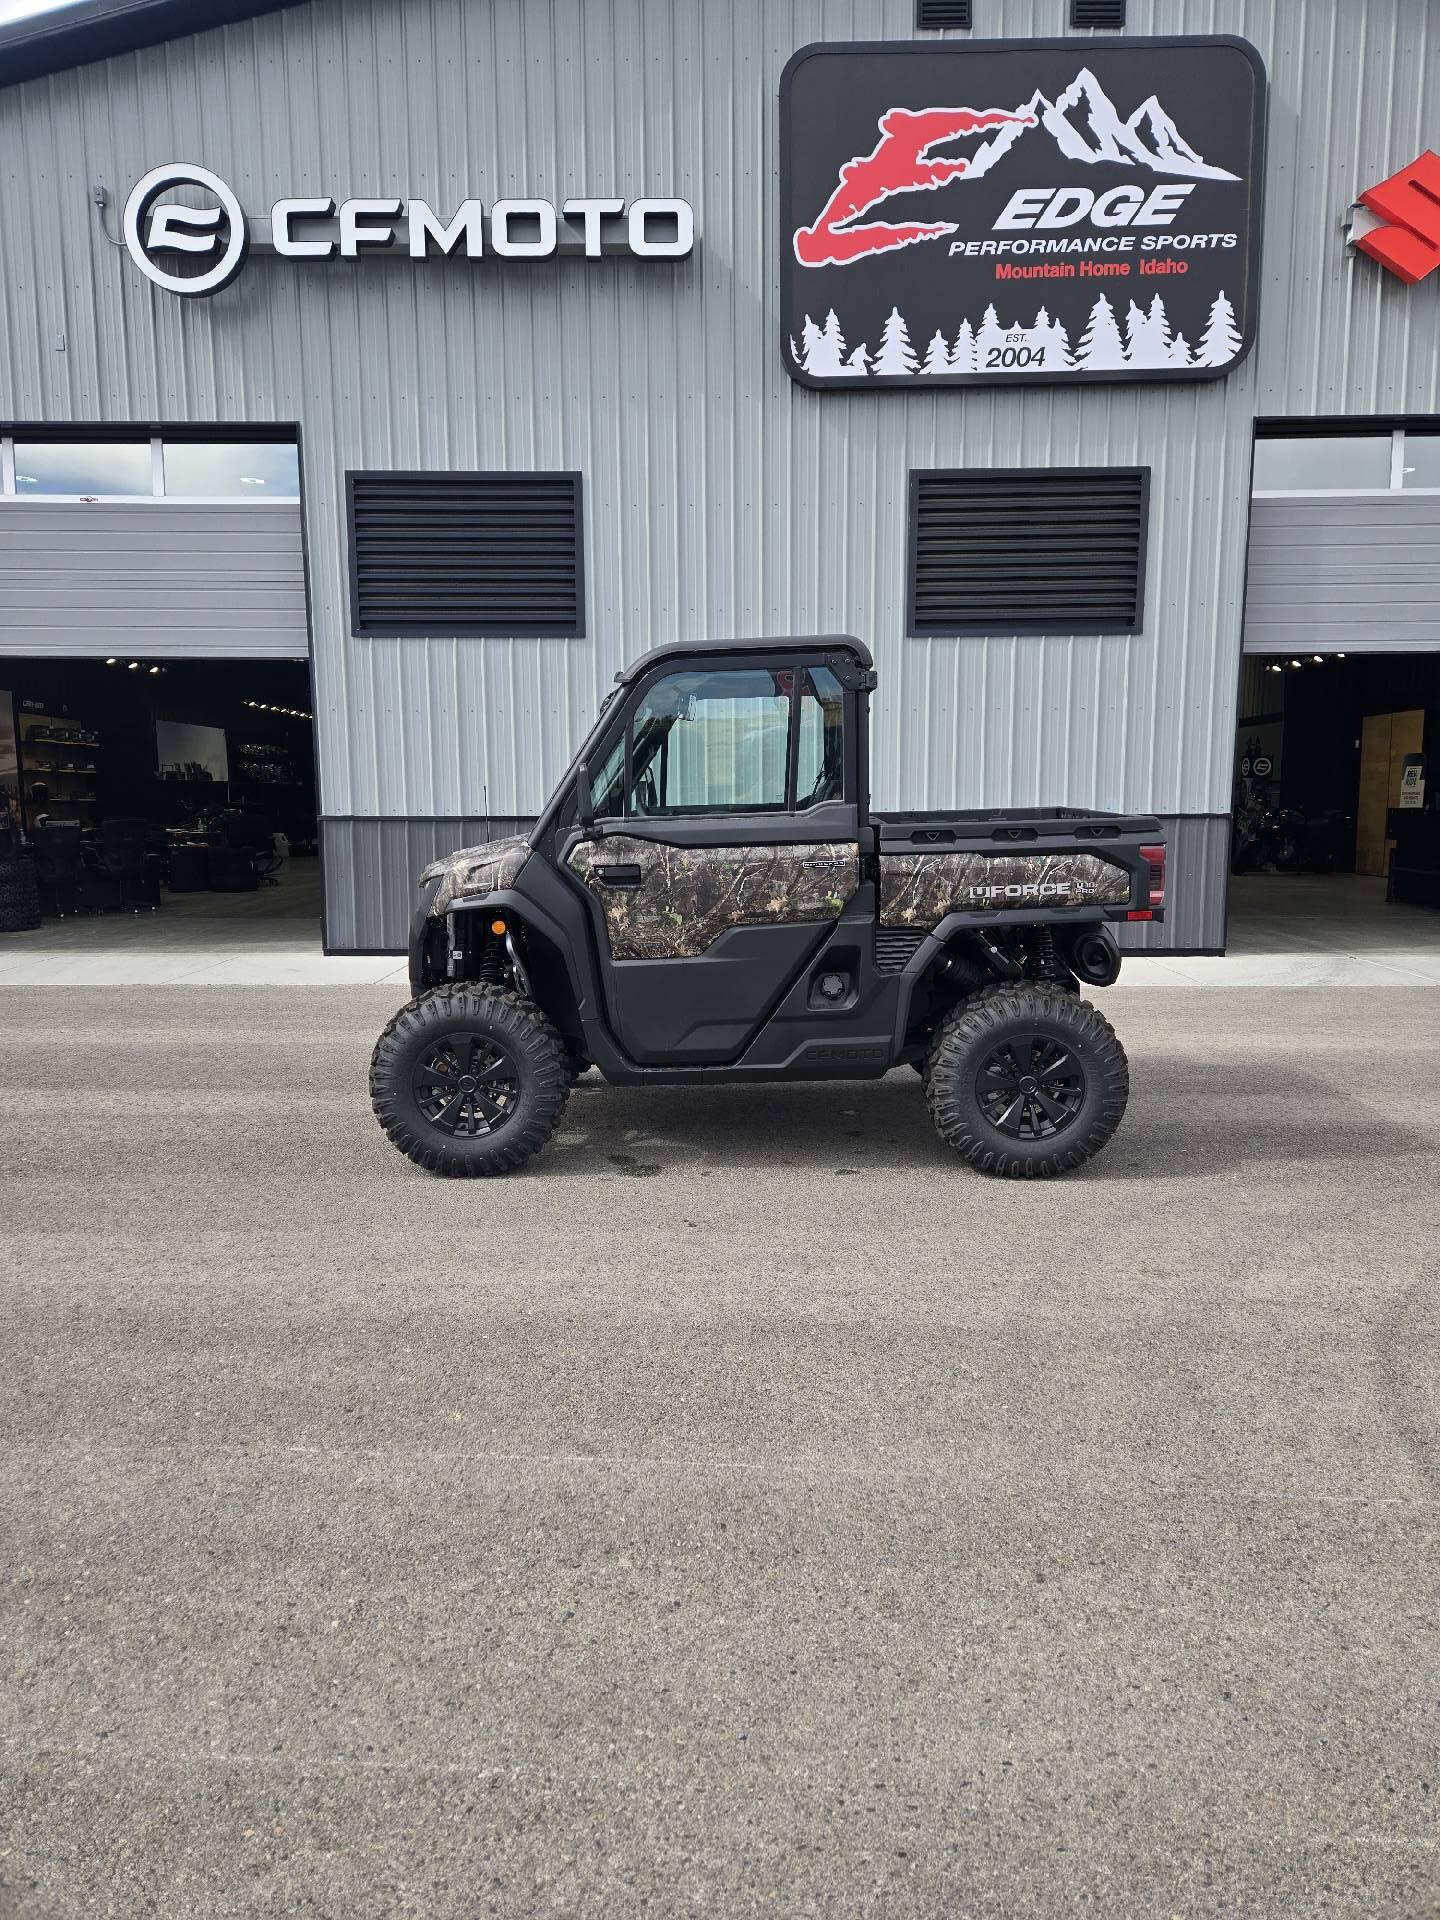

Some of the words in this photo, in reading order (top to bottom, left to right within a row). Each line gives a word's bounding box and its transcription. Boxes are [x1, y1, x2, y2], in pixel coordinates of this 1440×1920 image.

[991, 183, 1197, 230] EDGE
[270, 197, 694, 260] CFMOTO
[948, 236, 1136, 257] PERFORMANCE
[1140, 233, 1238, 251] SPORTS
[995, 261, 1075, 280] Mountain
[1079, 260, 1131, 277] Home
[1139, 258, 1189, 275] Idaho
[1005, 333, 1027, 343] EST.
[986, 346, 1046, 368] 2004
